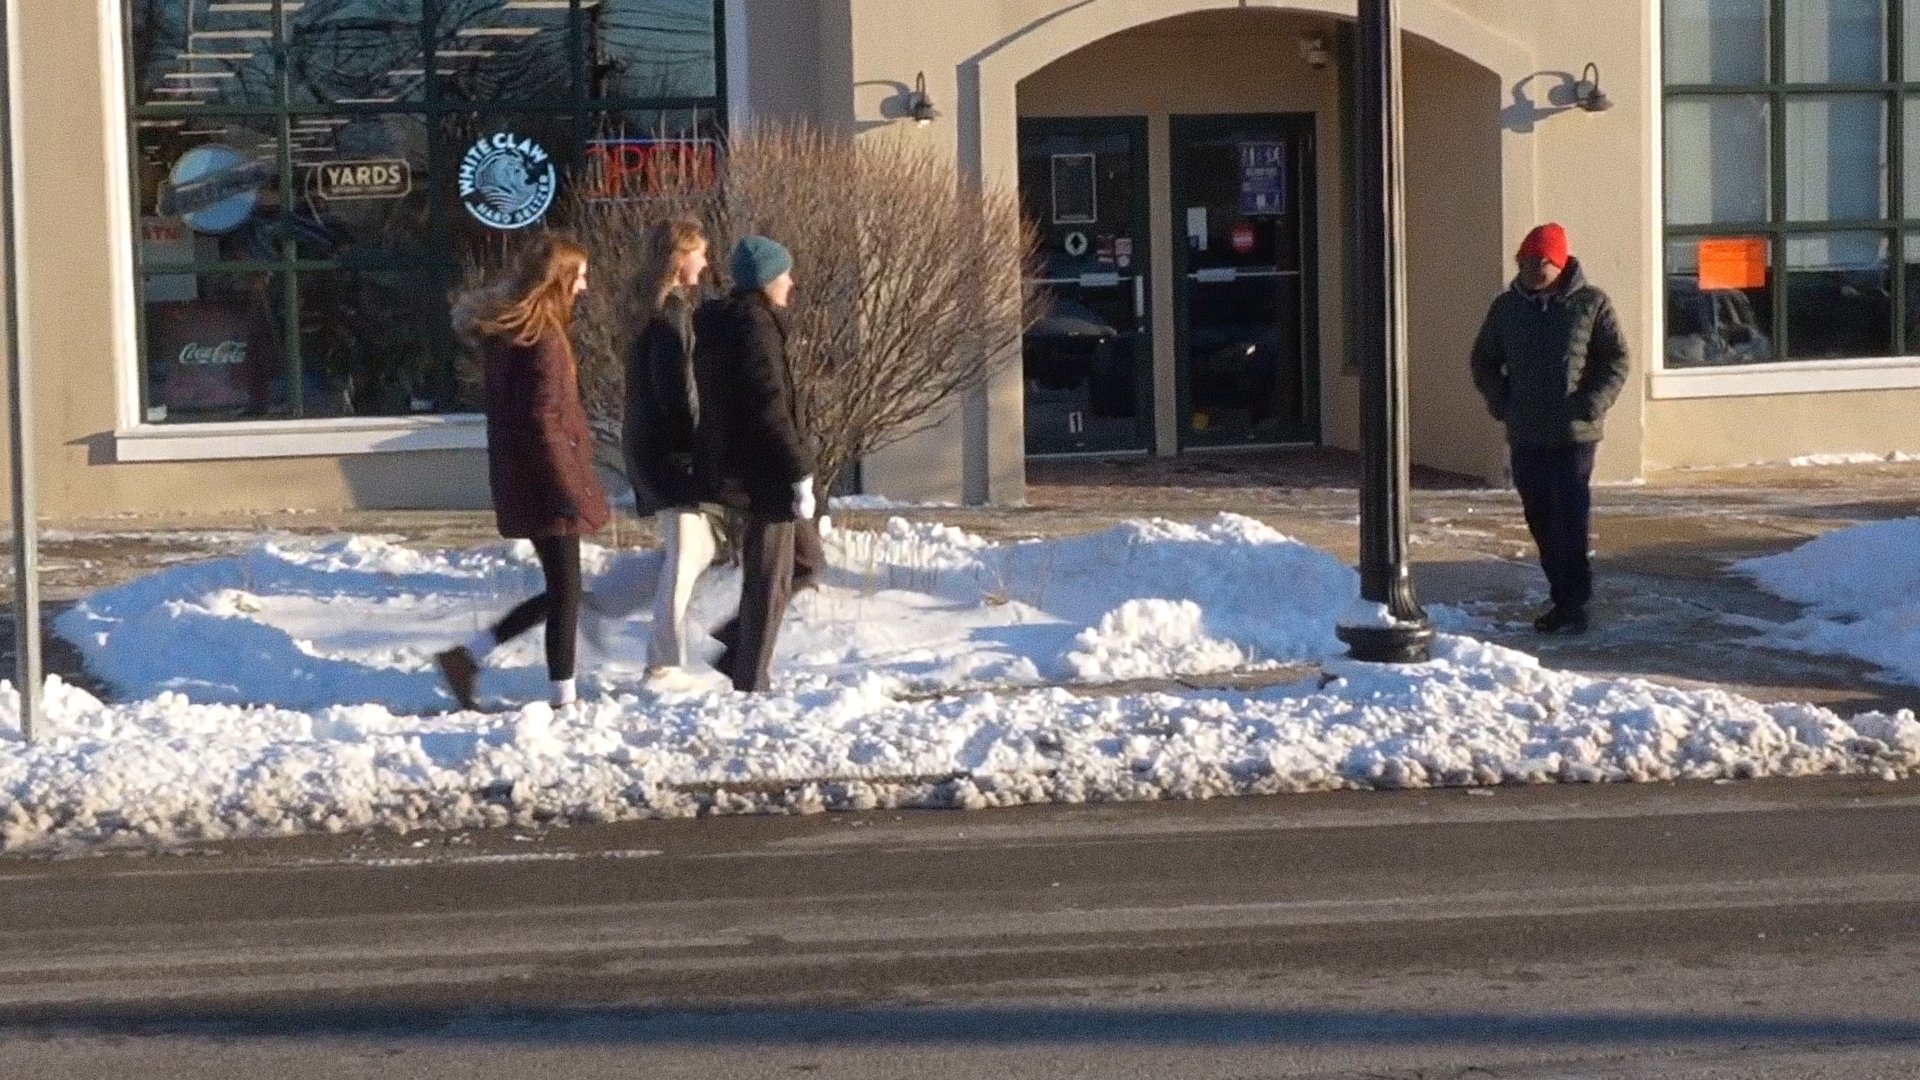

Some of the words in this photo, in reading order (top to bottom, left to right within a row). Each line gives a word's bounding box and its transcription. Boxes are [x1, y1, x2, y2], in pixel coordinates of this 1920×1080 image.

[327, 165, 402, 186] YARDS
[459, 139, 492, 196] WHITE
[493, 133, 548, 162] CLAW
